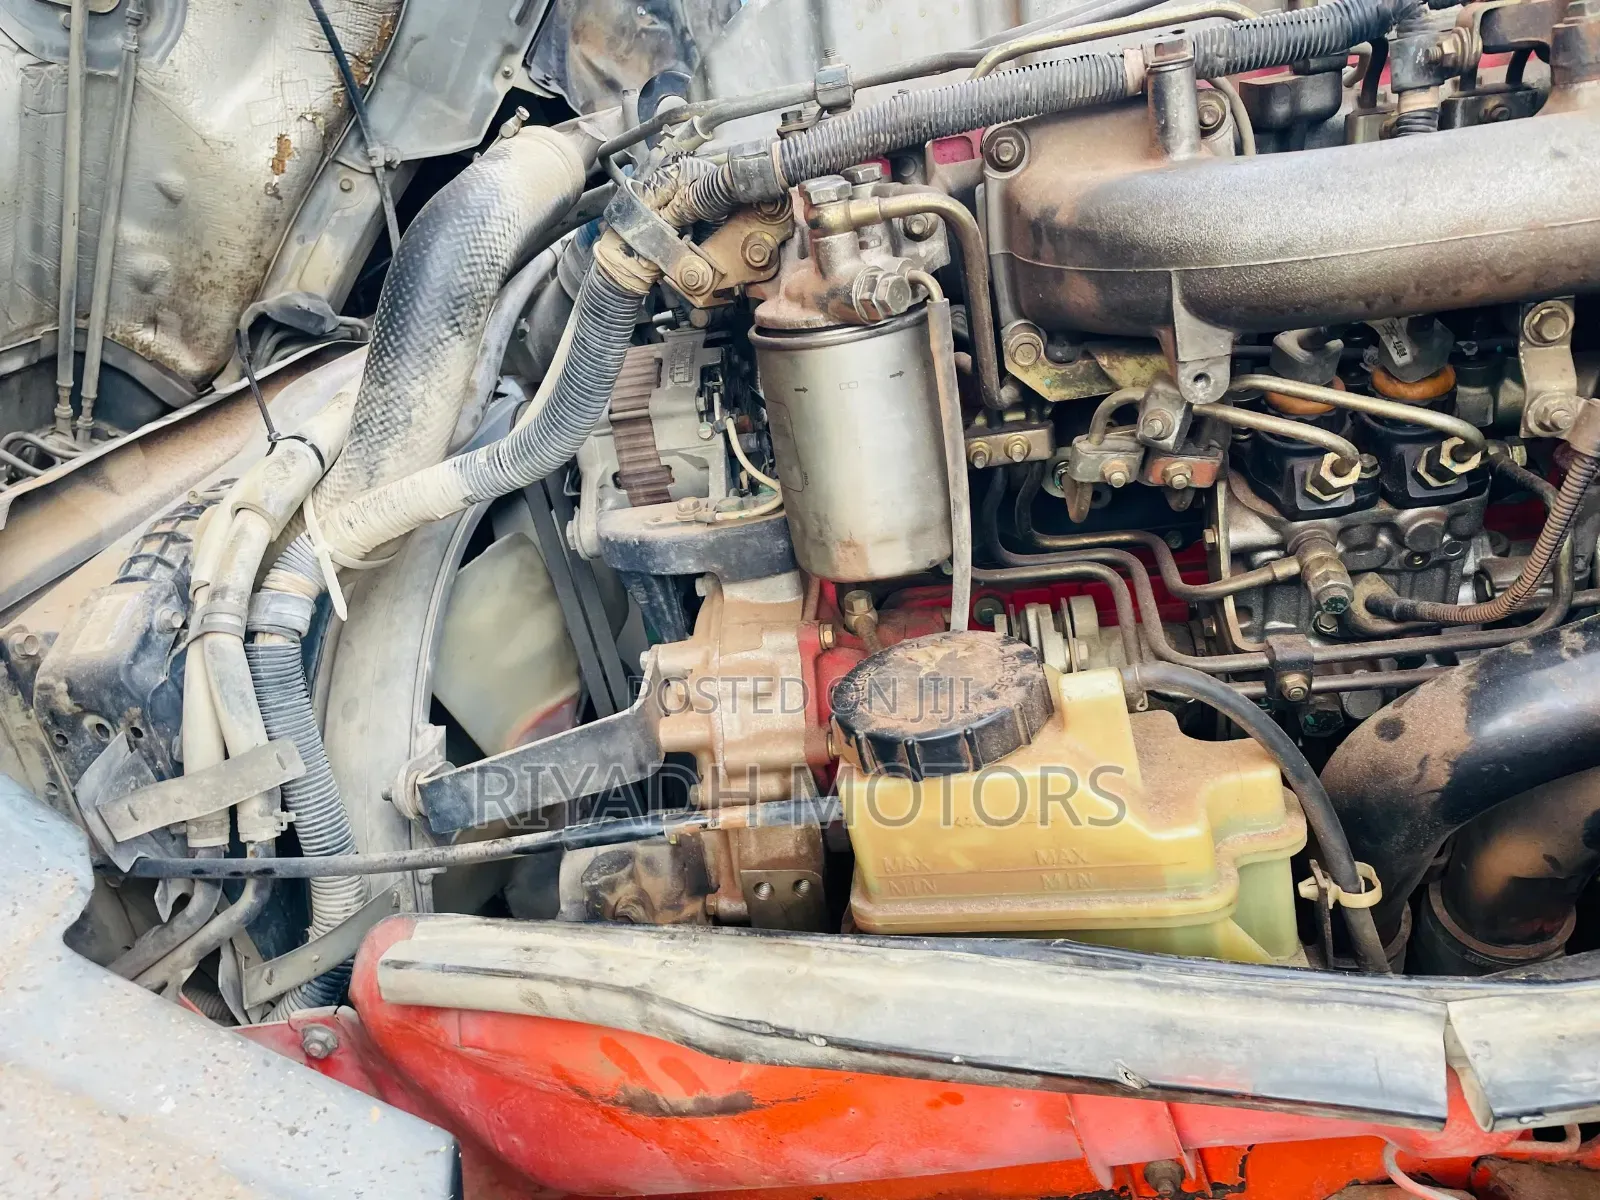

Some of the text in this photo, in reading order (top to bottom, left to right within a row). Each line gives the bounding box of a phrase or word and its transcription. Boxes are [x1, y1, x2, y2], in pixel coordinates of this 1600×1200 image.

[883, 855, 932, 873] MAX
[1034, 847, 1091, 867] MAX
[888, 878, 937, 895] MIN
[1041, 872, 1093, 891] MIN
